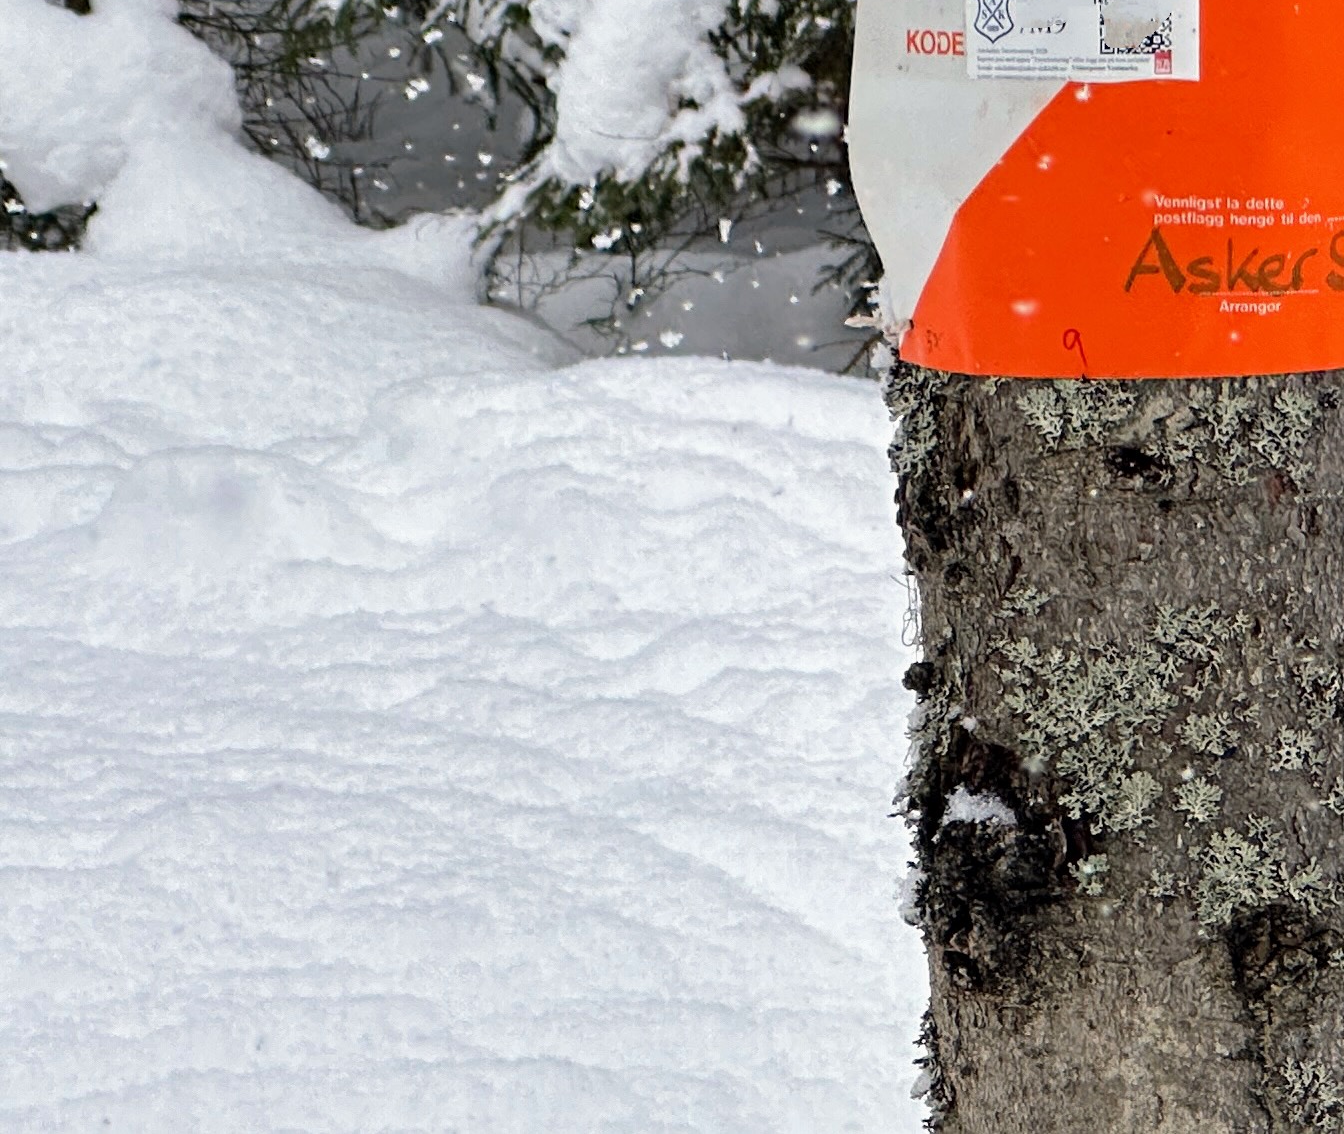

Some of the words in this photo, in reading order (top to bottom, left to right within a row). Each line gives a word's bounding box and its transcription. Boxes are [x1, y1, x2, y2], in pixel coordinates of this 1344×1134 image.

[907, 29, 965, 56] KODE
[1154, 194, 1222, 211] Vennligst
[1226, 197, 1240, 210] la
[1245, 197, 1285, 211] dette
[1153, 211, 1224, 227] postflagg
[1229, 212, 1275, 228] henge
[1280, 212, 1294, 225] til
[1298, 212, 1322, 225] den
[1123, 226, 1319, 295] Asker
